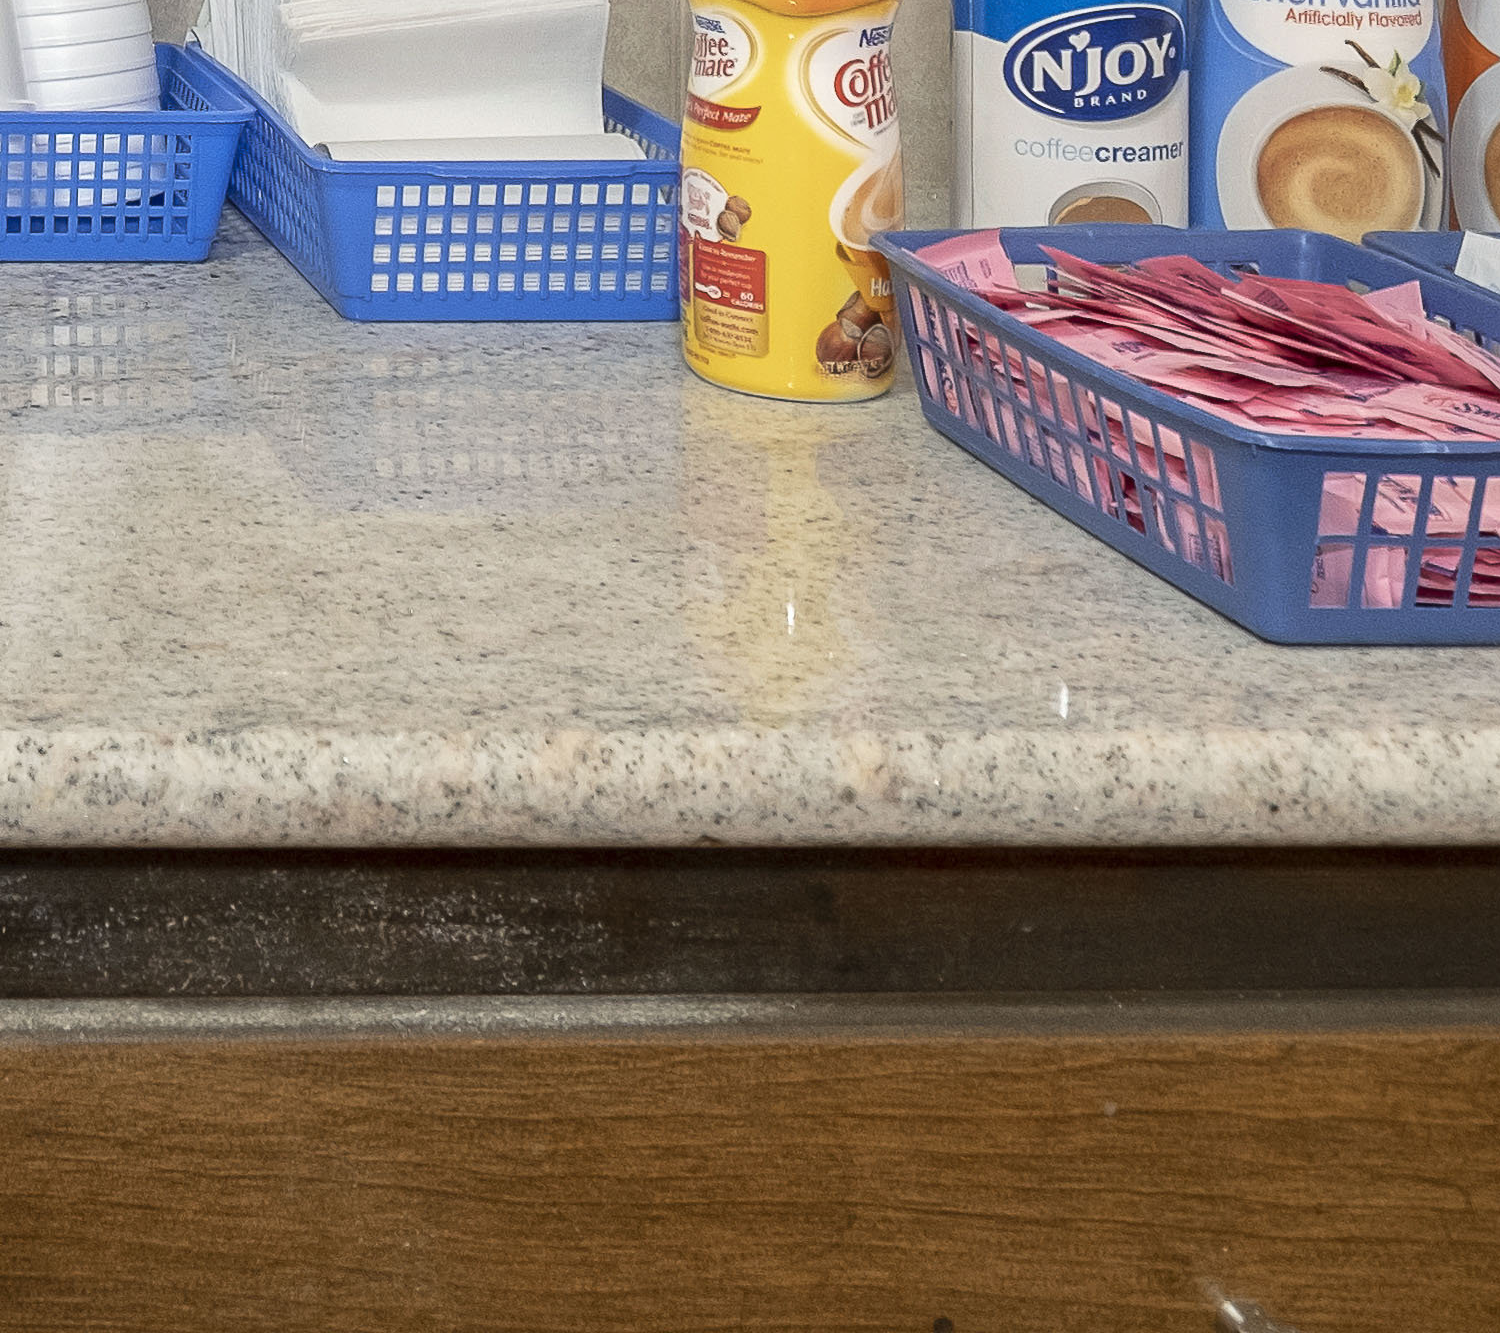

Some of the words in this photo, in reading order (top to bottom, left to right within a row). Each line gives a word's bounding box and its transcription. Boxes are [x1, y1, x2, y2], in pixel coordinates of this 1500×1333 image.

[1284, 7, 1363, 30] Artificially
[1368, 10, 1423, 27] Flavored
[1073, 89, 1148, 109] BRAND
